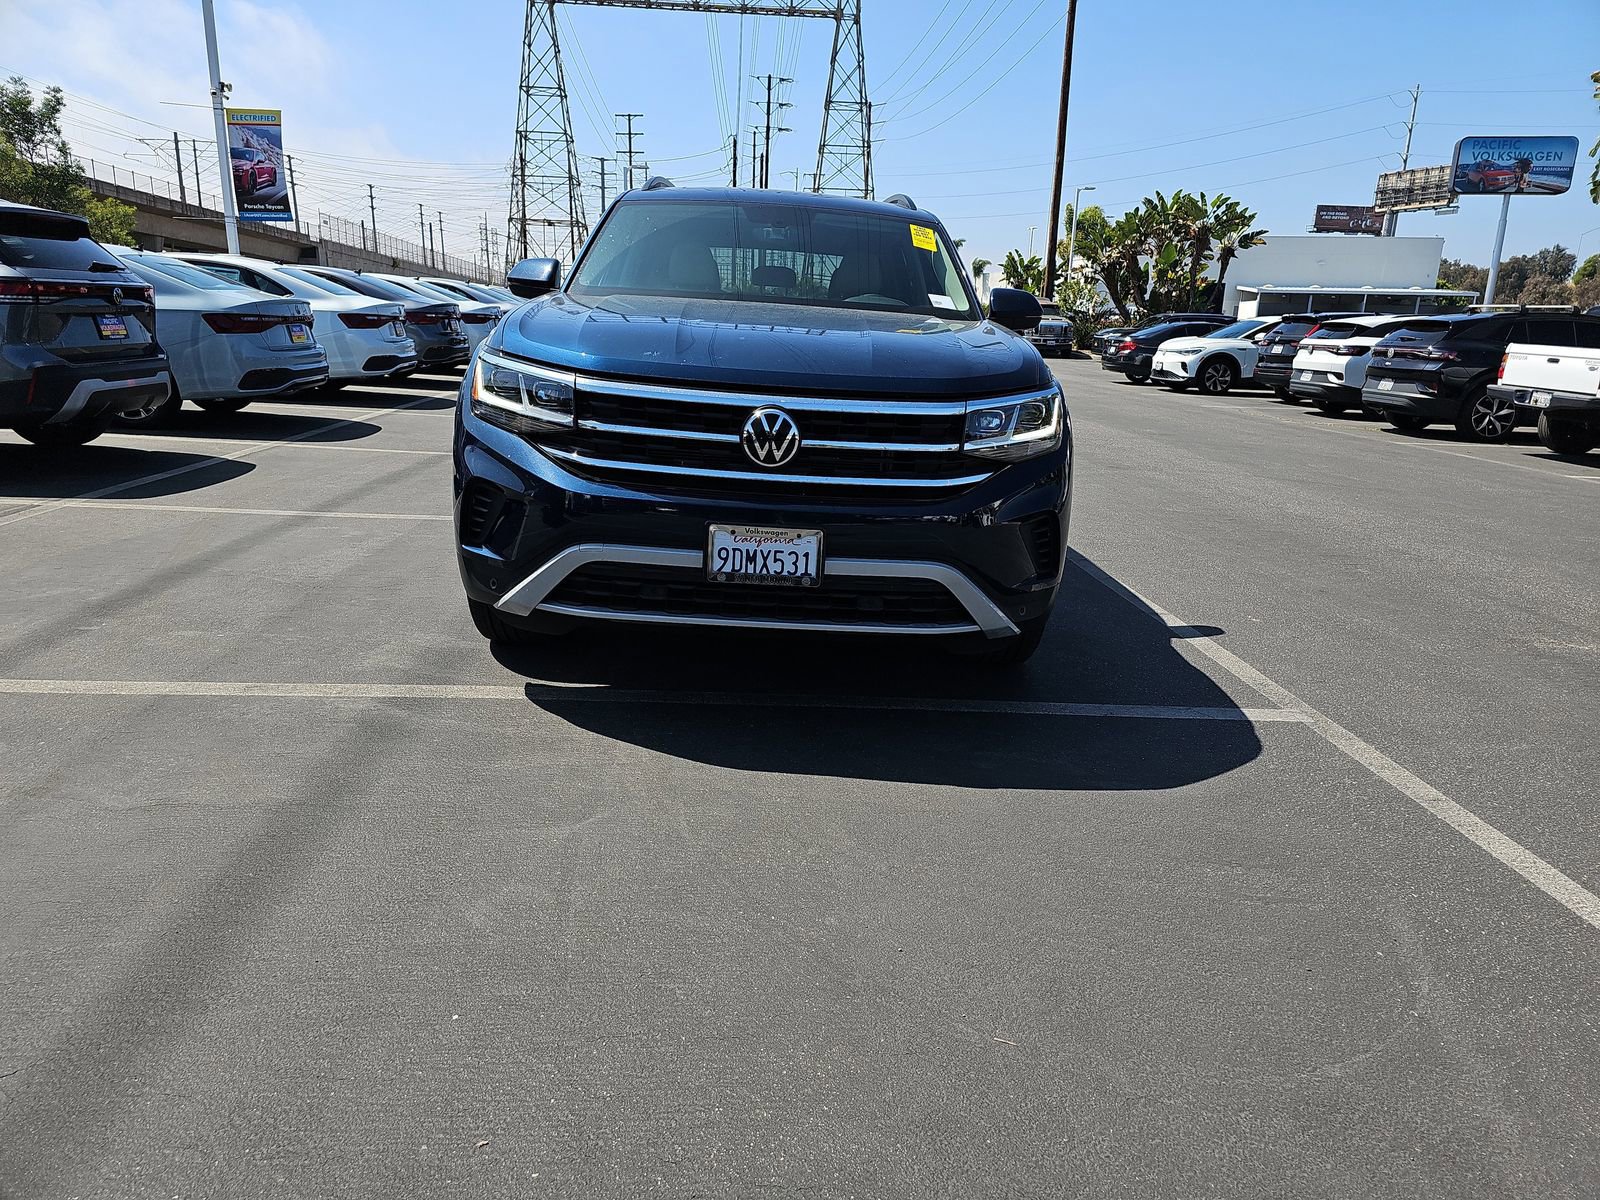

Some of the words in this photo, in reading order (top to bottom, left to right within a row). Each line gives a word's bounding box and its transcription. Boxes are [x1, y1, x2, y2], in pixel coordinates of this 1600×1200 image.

[231, 114, 277, 122] ELECTRIFIED
[1472, 140, 1521, 150] PACIFIC
[1472, 151, 1563, 161] VOLKSWAGEN
[745, 528, 788, 537] Volkswagen
[733, 535, 799, 548] California
[716, 547, 812, 577] 9DMX531
